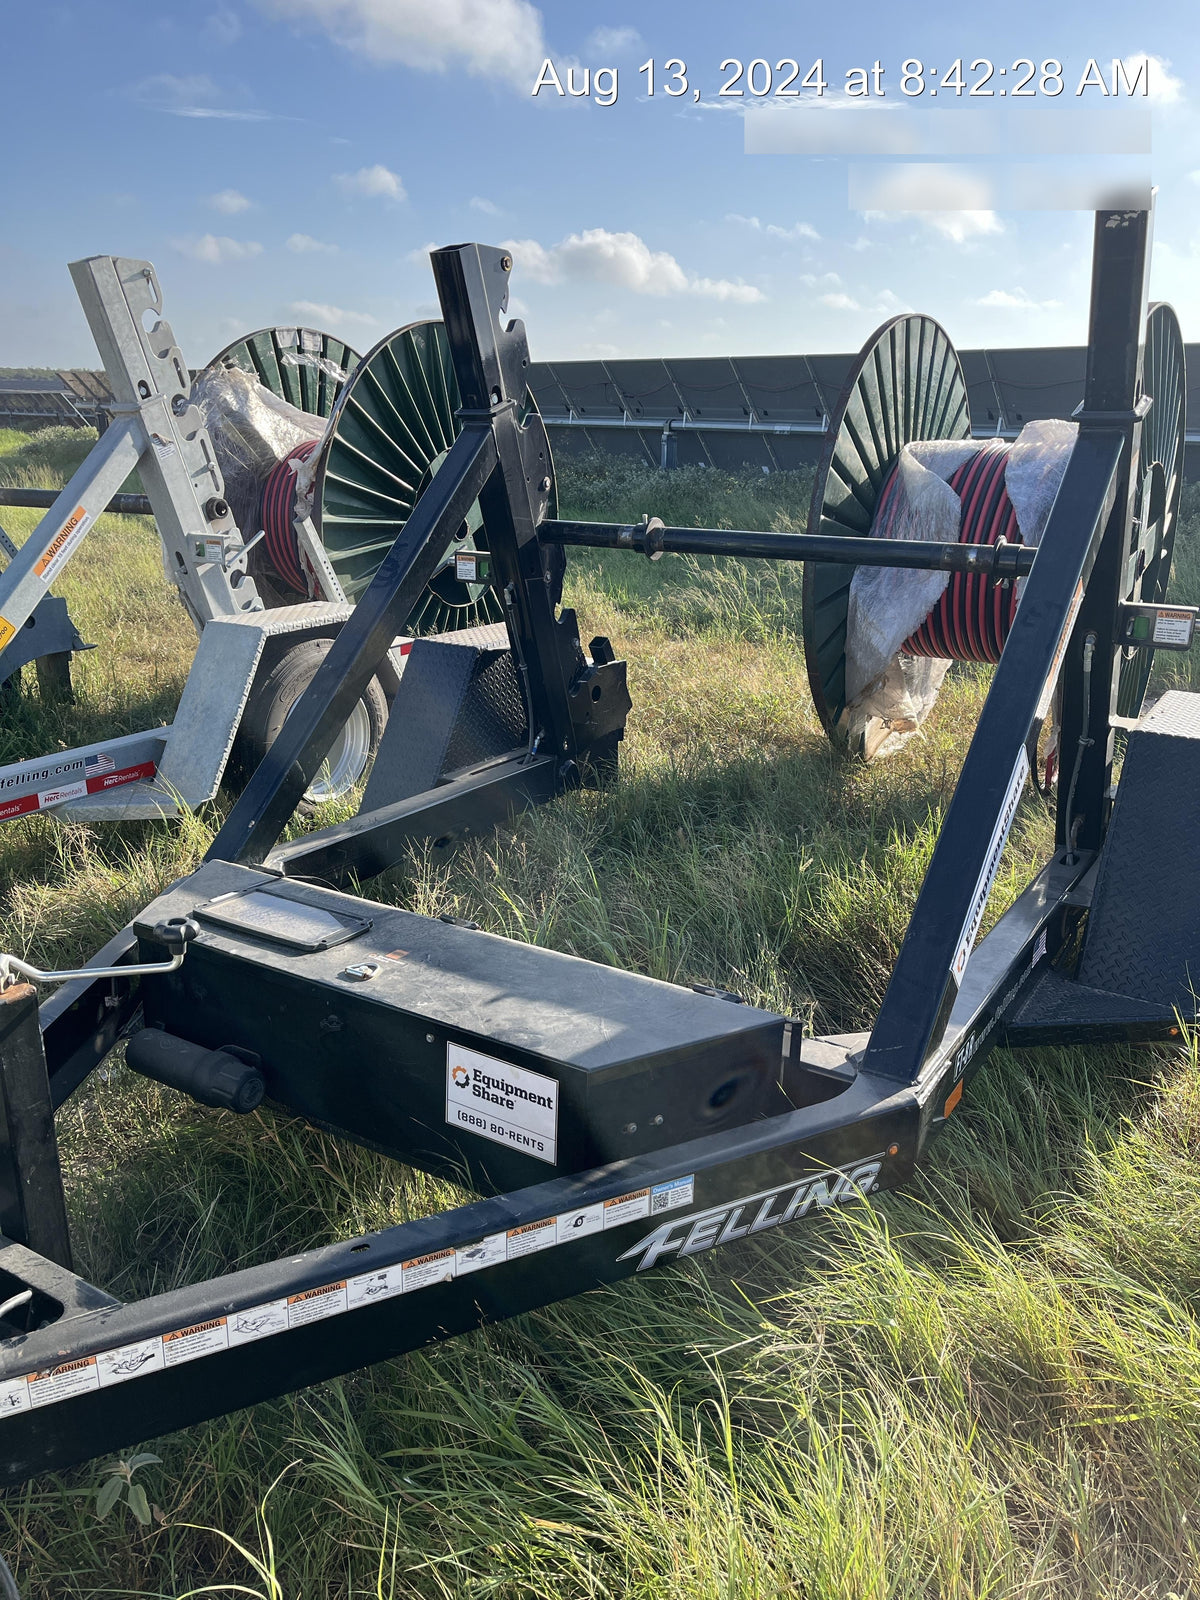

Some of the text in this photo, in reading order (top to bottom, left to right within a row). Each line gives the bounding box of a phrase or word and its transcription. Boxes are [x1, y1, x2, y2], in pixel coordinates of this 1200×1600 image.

[46, 517, 79, 558] WARNING
[104, 771, 139, 787] HercRentals
[44, 787, 83, 803] HercRentals
[472, 1084, 515, 1110] Share
[473, 1068, 553, 1110] Equipment
[457, 1110, 544, 1152] (888) 80-RENTS
[619, 1189, 647, 1203] WARNING
[616, 1151, 885, 1272] FELLING
[521, 1219, 552, 1233] WARNING
[417, 1250, 451, 1265] WARNING
[304, 1283, 341, 1299] WARNING
[181, 1320, 221, 1337] WARNING
[51, 1359, 90, 1376] ARNING
